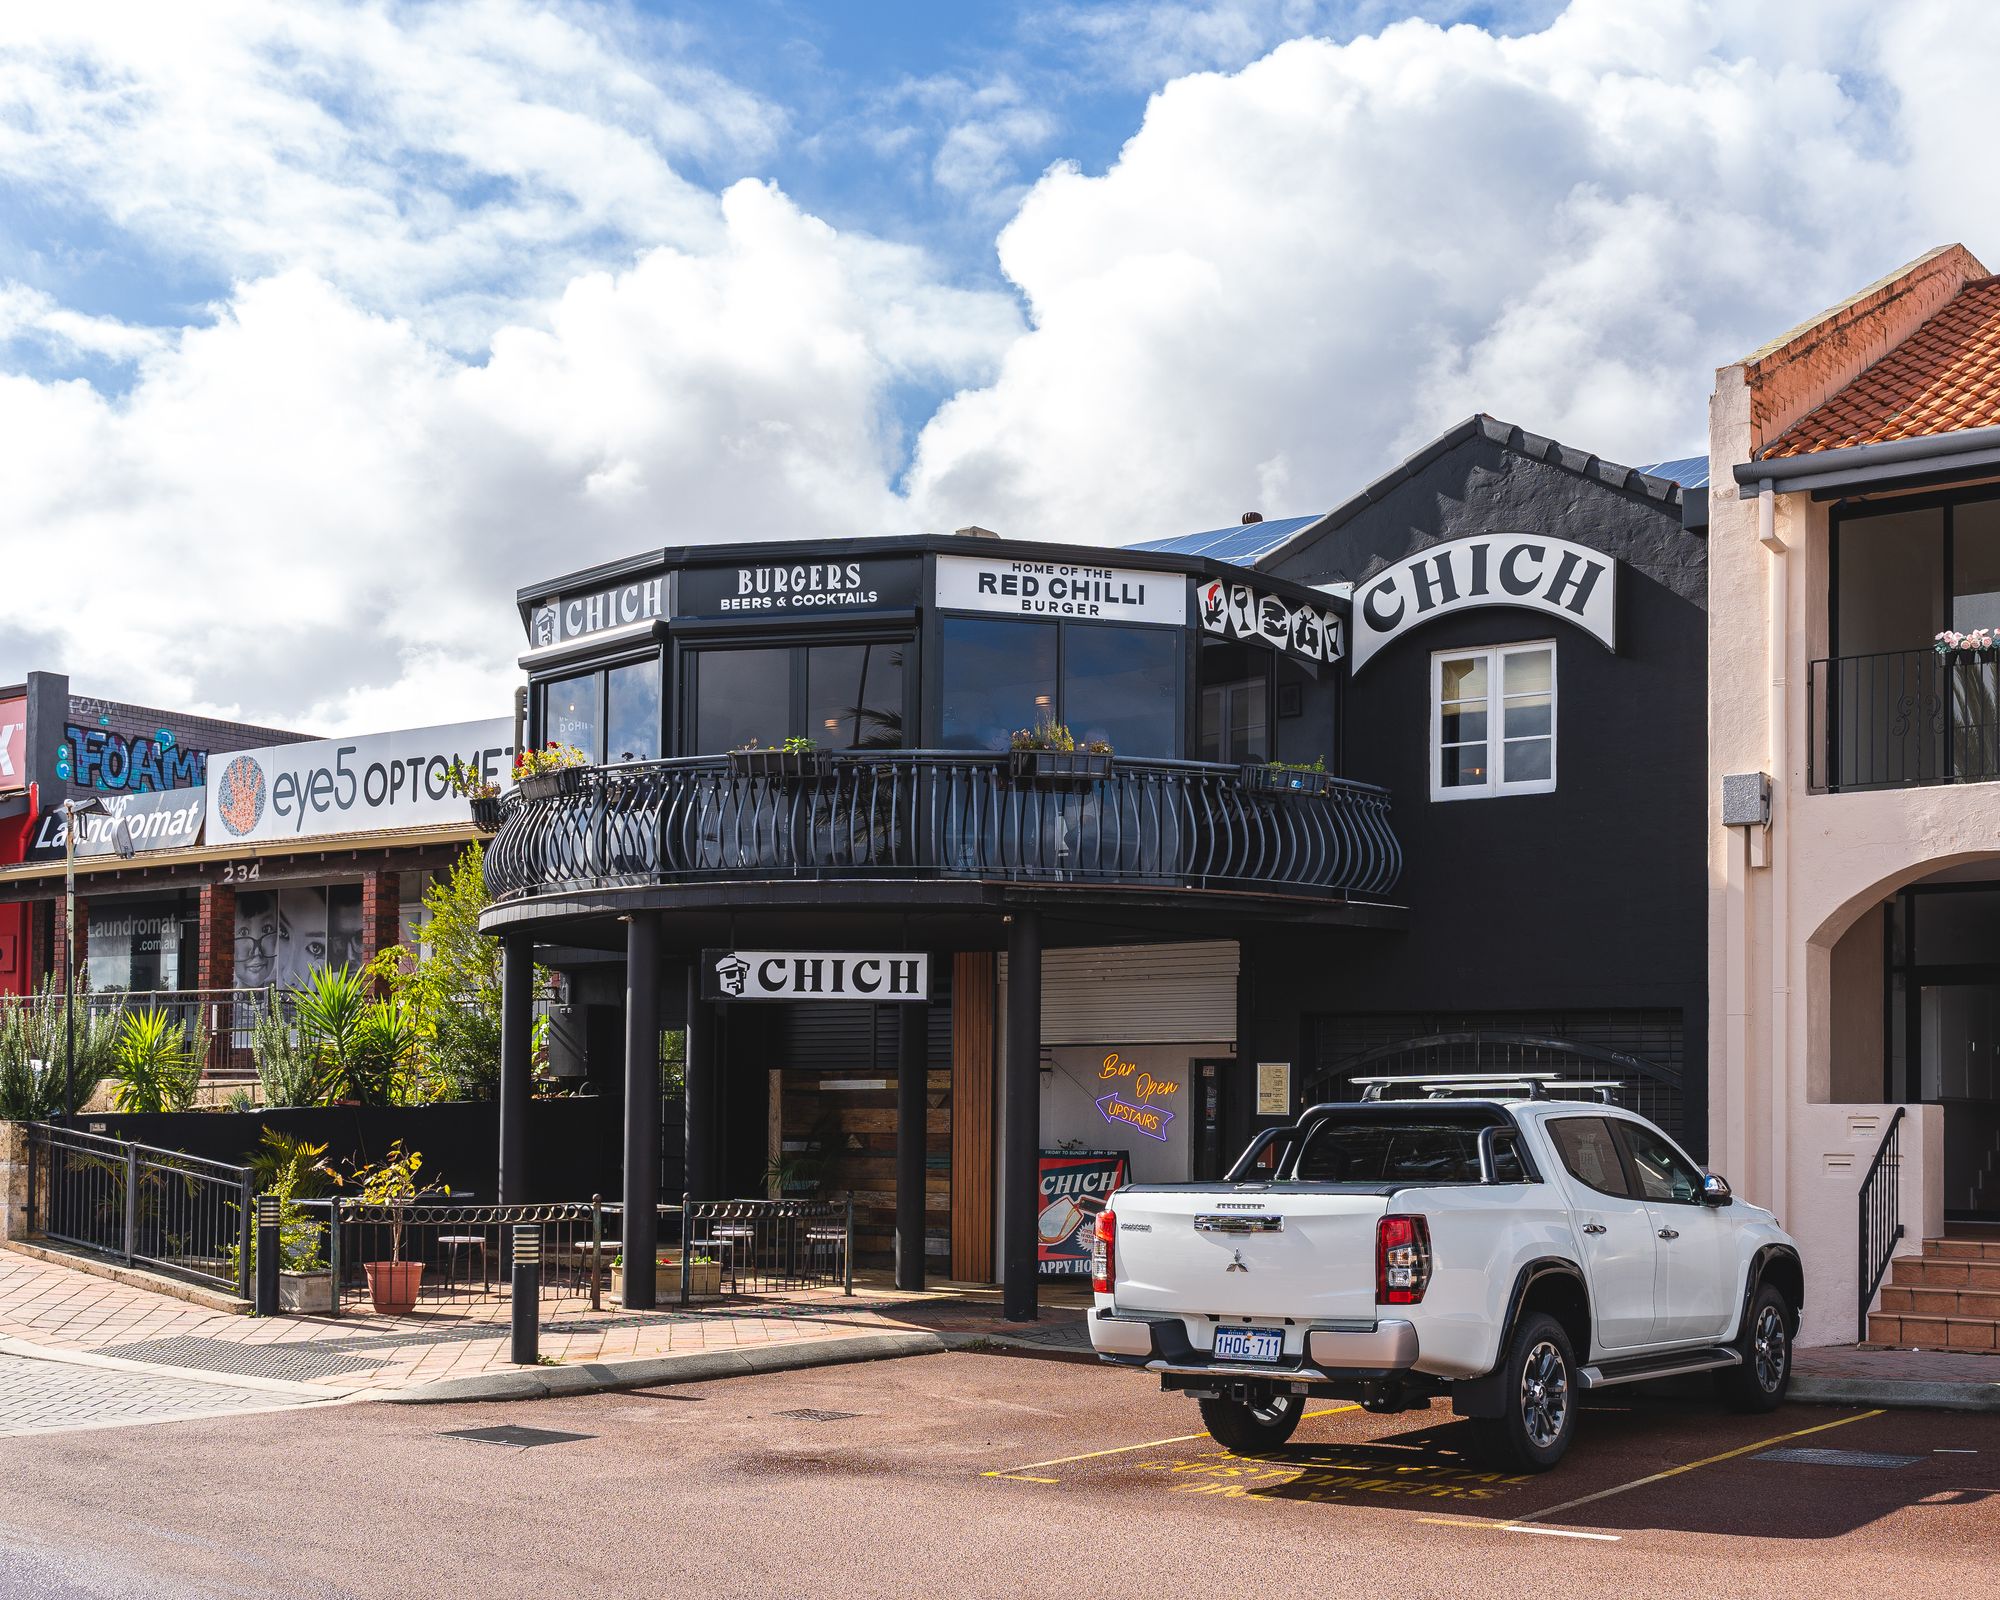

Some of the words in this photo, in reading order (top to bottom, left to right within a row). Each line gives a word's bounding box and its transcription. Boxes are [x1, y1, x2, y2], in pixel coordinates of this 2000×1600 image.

[738, 563, 861, 595] BURGERS
[1011, 562, 1058, 575] HOME
[1059, 565, 1081, 577] OF
[1083, 567, 1113, 580] THE
[720, 595, 773, 611] BEERS
[776, 597, 788, 607] &
[792, 590, 879, 607] COCKTAILS
[978, 571, 1039, 597] RED
[1048, 577, 1146, 606] CHILLI
[1362, 542, 1606, 633] CHICH
[566, 577, 664, 637] CHICH
[1021, 599, 1101, 617] BURGER
[64, 722, 209, 793] FOAM
[271, 746, 358, 833] eye5
[223, 862, 260, 882] 234
[88, 913, 176, 938] Laundromat
[139, 937, 176, 952] .com.au
[757, 958, 921, 994] CHICH
[1098, 1053, 1137, 1079] Bar
[1136, 1072, 1179, 1104] Open
[1108, 1101, 1160, 1130] UPSTAIRS
[1039, 1171, 1120, 1196] CHICH
[1038, 1260, 1073, 1275] APPY
[1074, 1259, 1092, 1273] HO
